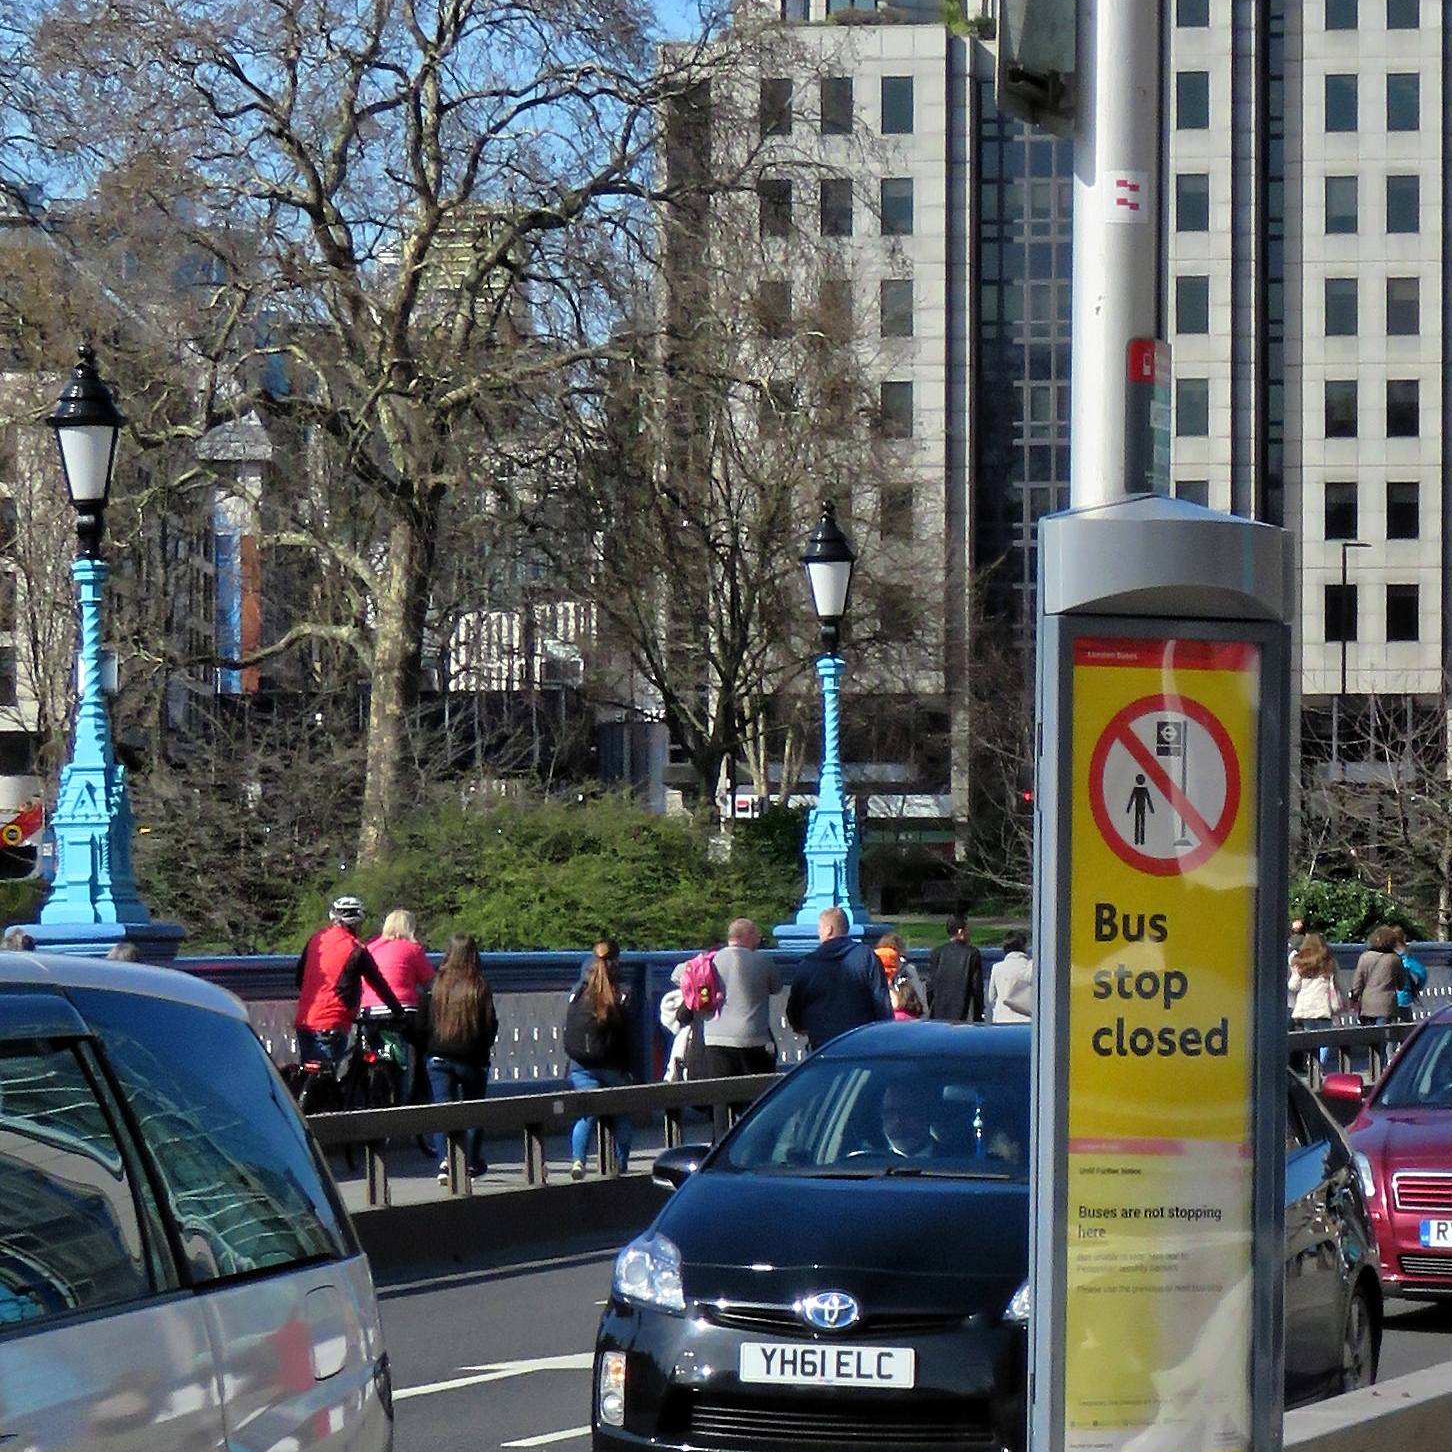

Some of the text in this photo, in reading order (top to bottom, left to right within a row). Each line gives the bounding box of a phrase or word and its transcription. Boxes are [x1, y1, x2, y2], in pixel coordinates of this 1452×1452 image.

[1093, 902, 1169, 943] Bus
[1092, 963, 1189, 1009] stop
[1091, 1017, 1230, 1058] closed
[1077, 1224, 1107, 1239] here
[1078, 1205, 1223, 1223] Buses are not stopping
[761, 1347, 894, 1380] YH61 ELC
